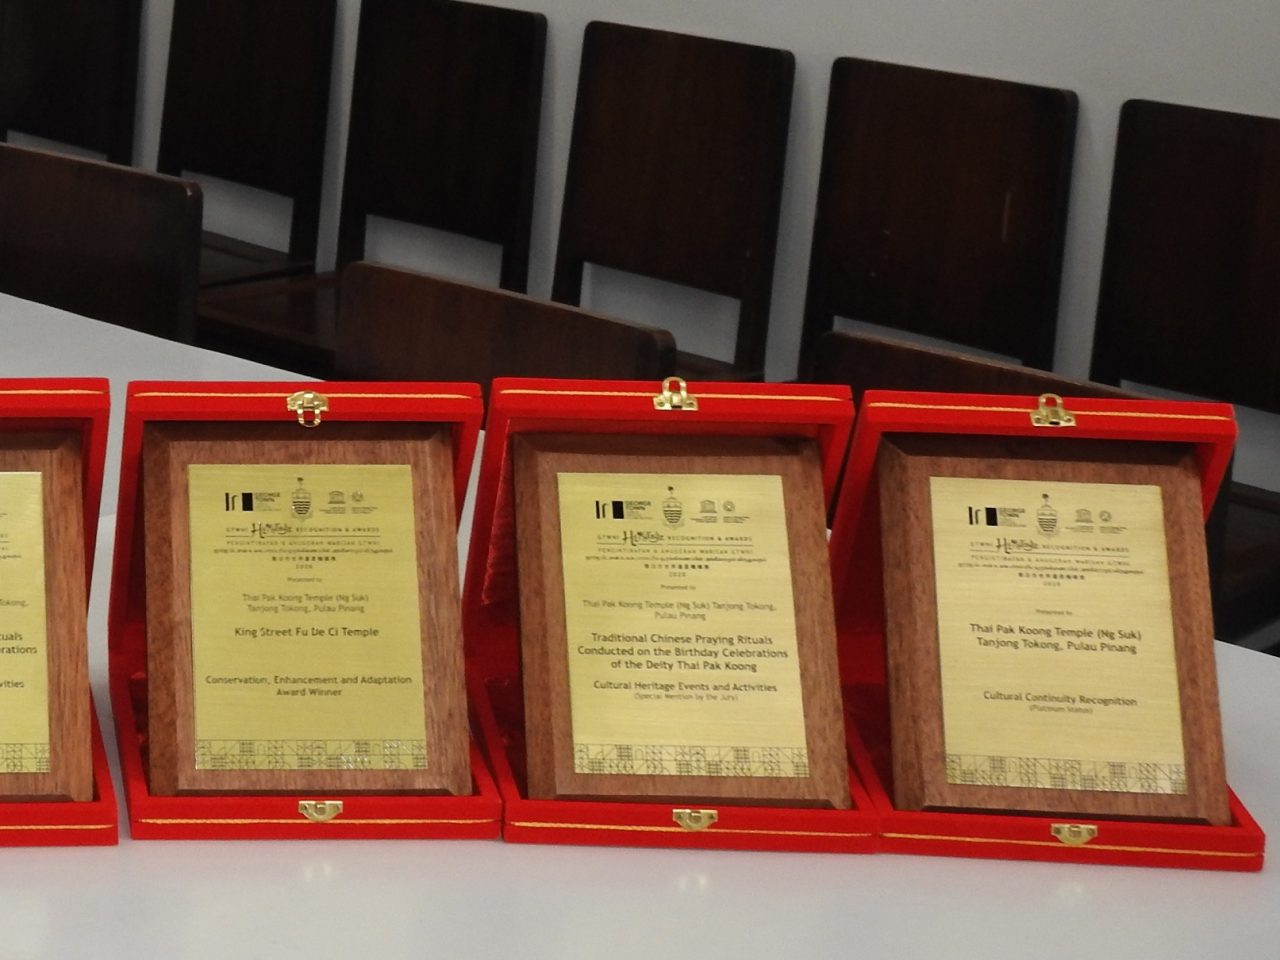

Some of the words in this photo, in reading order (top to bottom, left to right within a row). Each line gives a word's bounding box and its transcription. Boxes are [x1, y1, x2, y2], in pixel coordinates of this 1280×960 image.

[234, 628, 257, 638] King
[259, 628, 292, 636] Street
[295, 628, 308, 636] Fu
[311, 628, 325, 636] De
[327, 628, 338, 636] Ci
[341, 628, 379, 638] Temple
[969, 624, 993, 632] Thai
[996, 624, 1015, 633] Pak
[1018, 625, 1052, 636] Koong
[1053, 626, 1093, 638] Temple
[1096, 628, 1115, 639] (Ng
[1117, 629, 1141, 640] Suk)
[591, 633, 647, 642] Traditional
[650, 634, 692, 643] Chinese
[695, 635, 734, 646] Praying
[737, 635, 773, 644] Rituals
[976, 637, 1019, 649] Tanjong
[1020, 639, 1064, 651] Tokong,
[1066, 641, 1097, 650] Pulau
[1099, 642, 1137, 654] Pinang
[577, 646, 634, 655] Conducted
[653, 647, 671, 656] the
[674, 648, 719, 659] Birthday
[721, 648, 788, 658] Celebrations
[610, 660, 621, 669] of
[624, 660, 643, 669] the
[645, 660, 673, 672] Deity
[676, 661, 699, 670] Thai
[702, 661, 721, 670] Pak
[724, 662, 757, 673] Koong
[205, 676, 270, 686] Conservation,
[273, 676, 338, 684] Enhancement
[340, 676, 358, 685] and
[360, 676, 412, 687] Adaptation
[593, 681, 631, 690] Cultural
[634, 681, 675, 692] Heritage
[678, 682, 709, 691] Events
[712, 682, 730, 691] and
[732, 683, 777, 692] Activities
[983, 691, 1023, 700] Cultural
[1024, 692, 1076, 704] Continuity
[1078, 694, 1137, 707] Recognition
